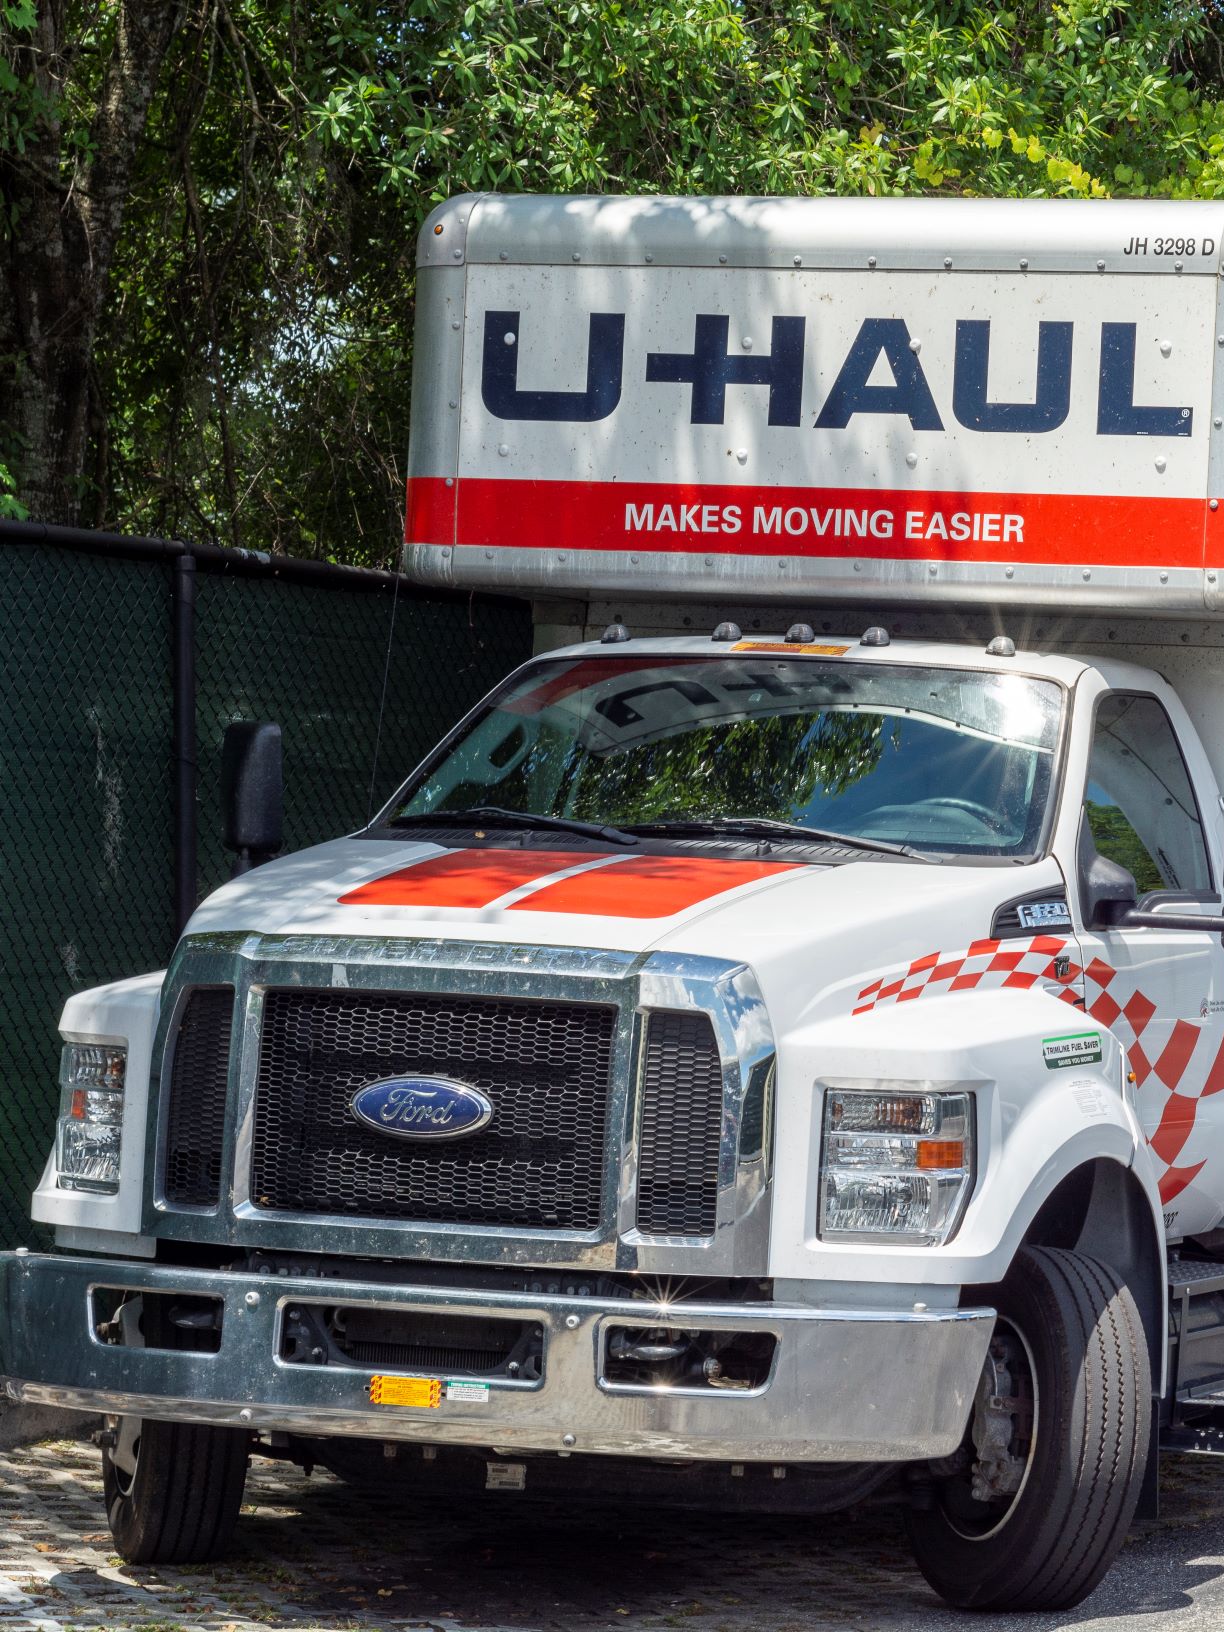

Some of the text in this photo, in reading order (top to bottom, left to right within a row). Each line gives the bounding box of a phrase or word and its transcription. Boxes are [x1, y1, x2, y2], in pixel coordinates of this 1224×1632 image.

[1123, 237, 1215, 256] JH 3298 D
[624, 502, 1025, 542] MAKES MOVING EASIER
[281, 935, 610, 969] SUPER DUTY
[380, 1088, 455, 1125] Ford
